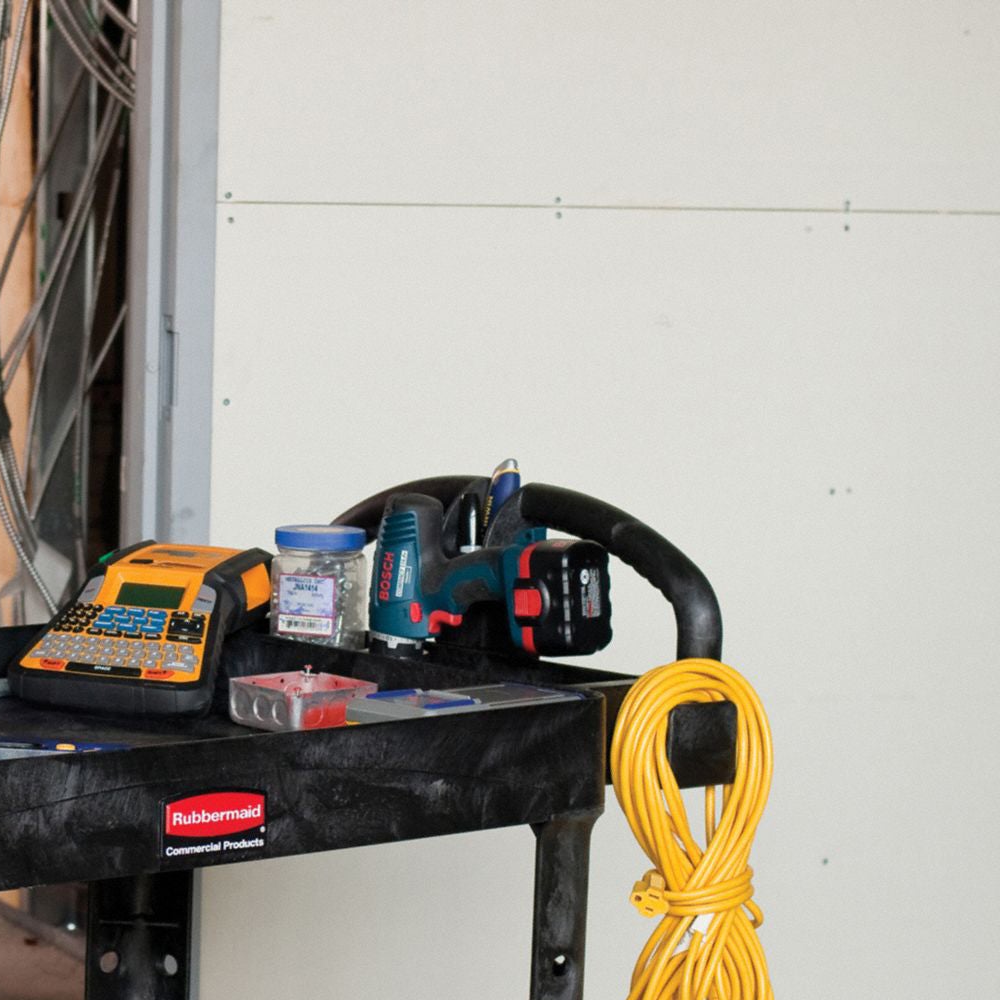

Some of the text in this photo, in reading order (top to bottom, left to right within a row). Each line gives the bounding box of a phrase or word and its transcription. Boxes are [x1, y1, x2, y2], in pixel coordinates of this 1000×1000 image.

[379, 551, 394, 601] BOSCH
[172, 804, 261, 826] Rubbermaid
[165, 838, 264, 856] Commercial Products
